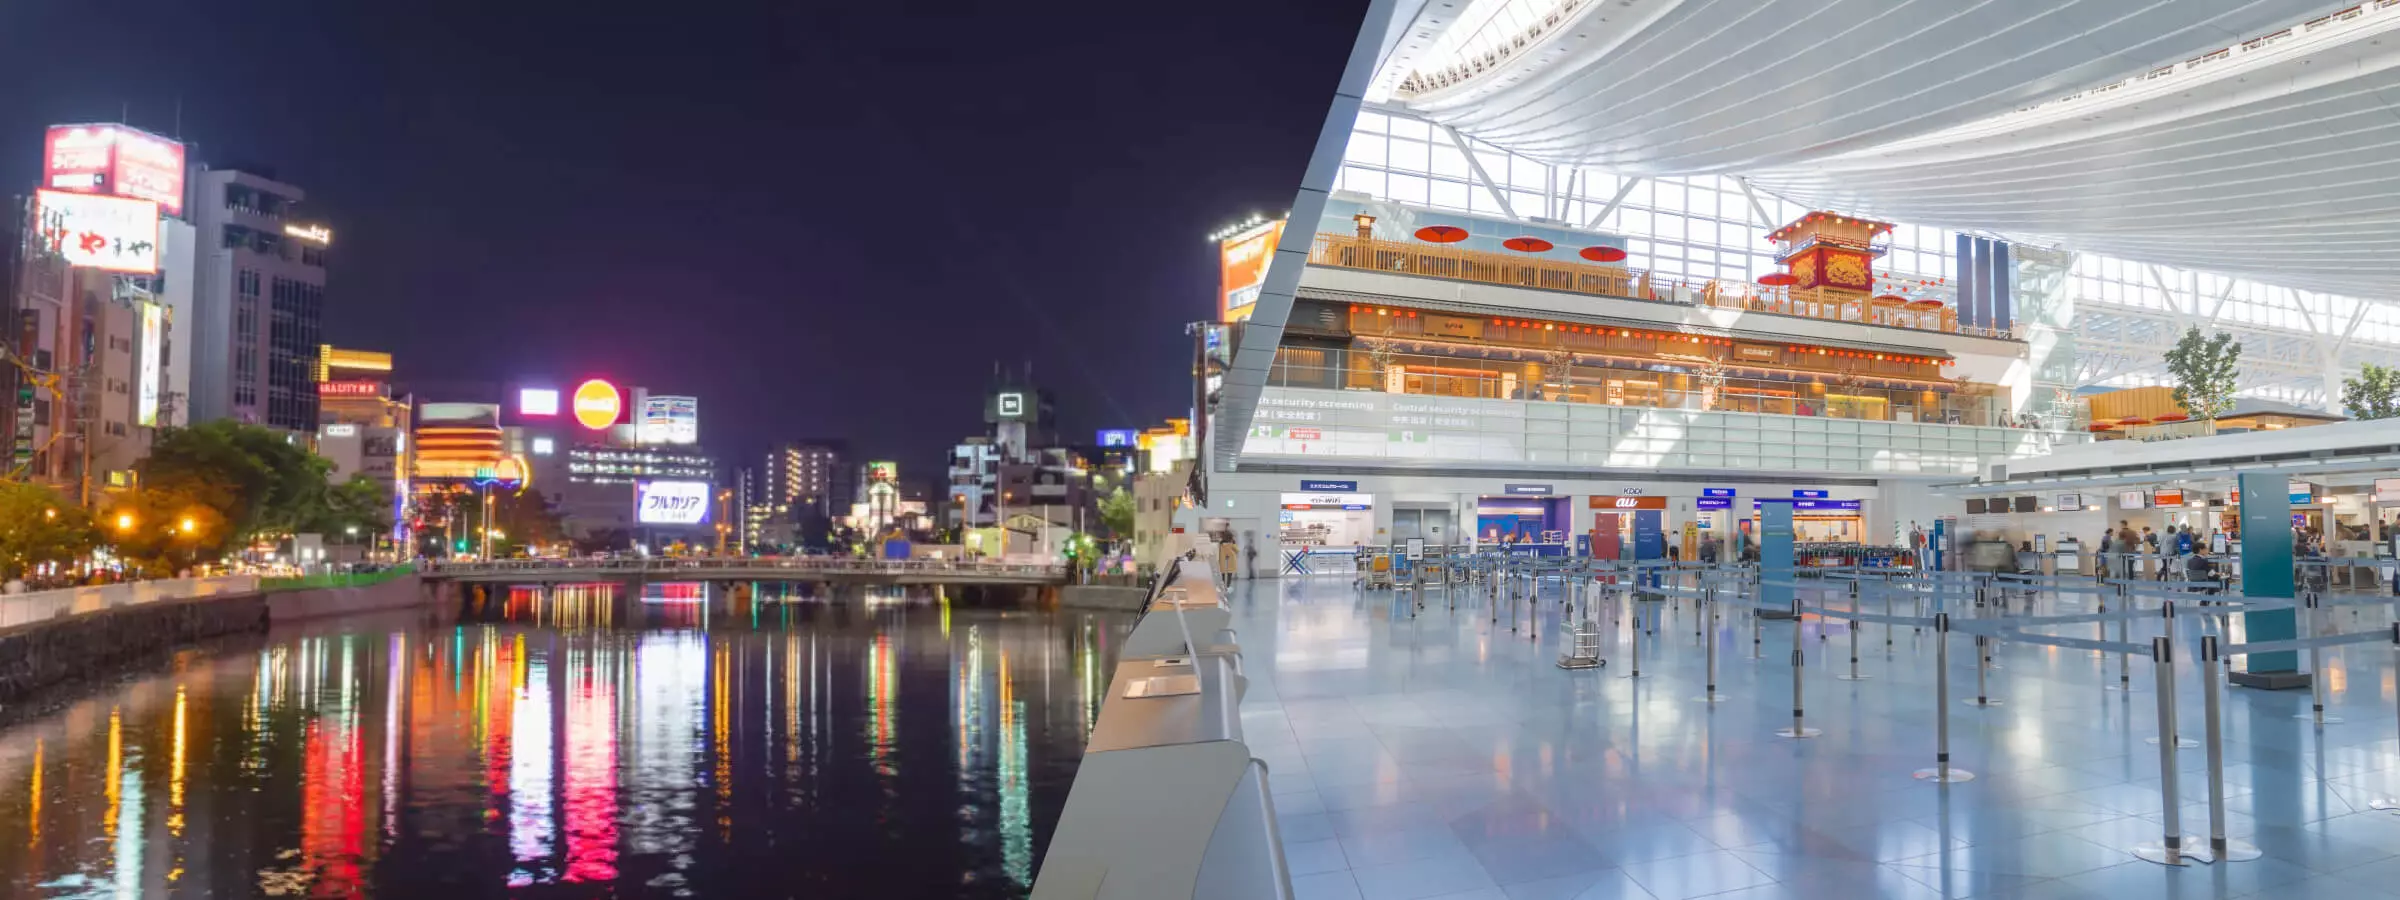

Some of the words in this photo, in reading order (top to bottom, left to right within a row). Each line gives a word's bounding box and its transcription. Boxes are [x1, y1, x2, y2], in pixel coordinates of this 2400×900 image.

[1272, 398, 1315, 408] security
[1319, 400, 1374, 410] screening
[1393, 402, 1428, 412] Central
[1430, 404, 1467, 415] security
[1623, 487, 1642, 496] KDDI
[1615, 498, 1638, 508] au
